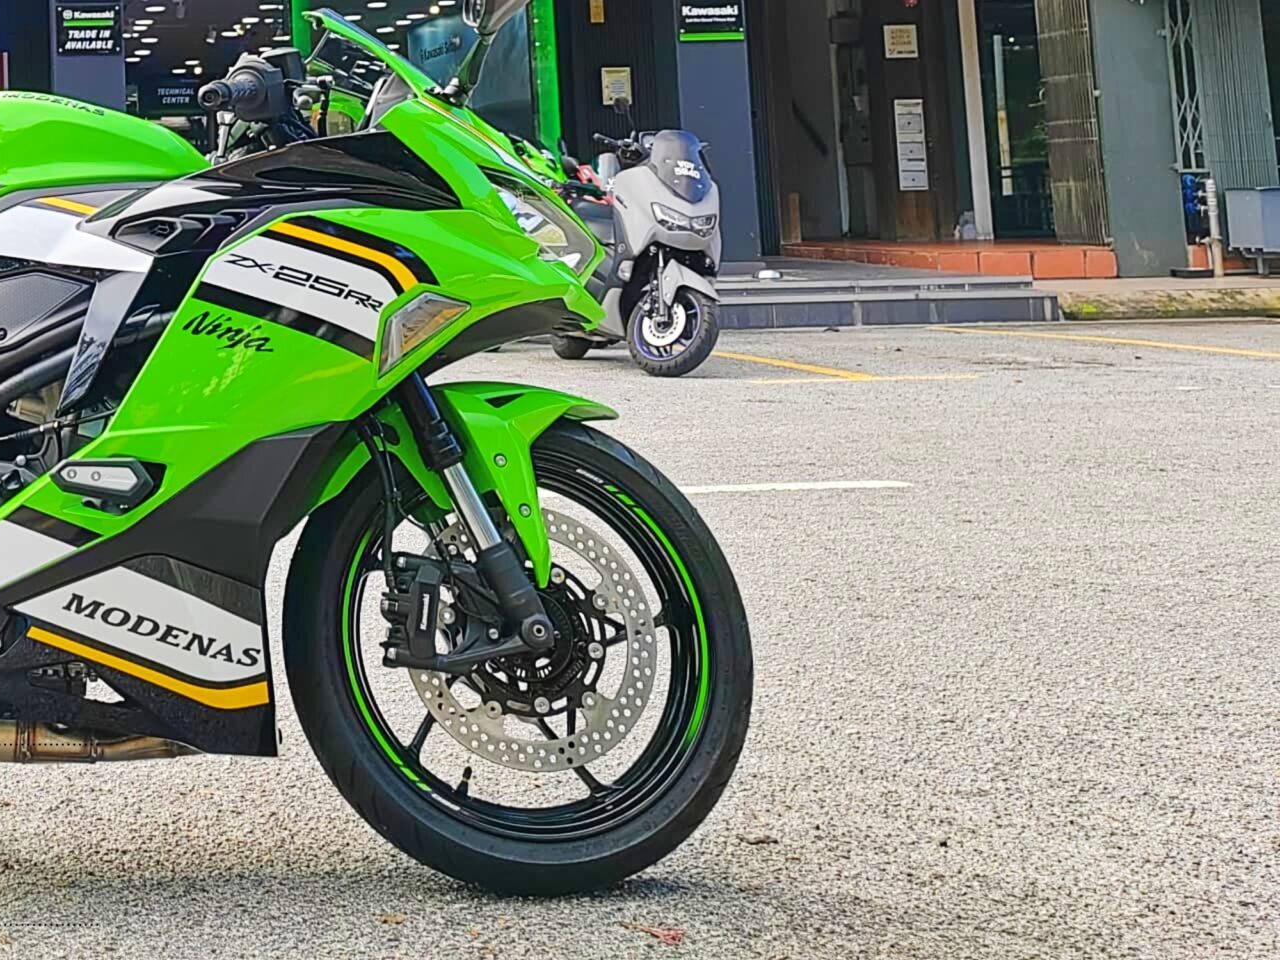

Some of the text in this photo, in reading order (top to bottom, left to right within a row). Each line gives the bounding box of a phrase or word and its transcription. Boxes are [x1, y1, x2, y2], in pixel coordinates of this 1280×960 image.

[74, 11, 114, 19] Kawasaki
[682, 5, 738, 16] Kawasaki
[68, 30, 111, 39] TRADE IN
[65, 40, 114, 50] AVAILABLE
[157, 87, 194, 96] TECHNICAL
[2, 93, 106, 117] MODENAS
[162, 96, 190, 104] CENTER
[182, 311, 274, 352] Ninja
[62, 593, 262, 667] MODENAS
